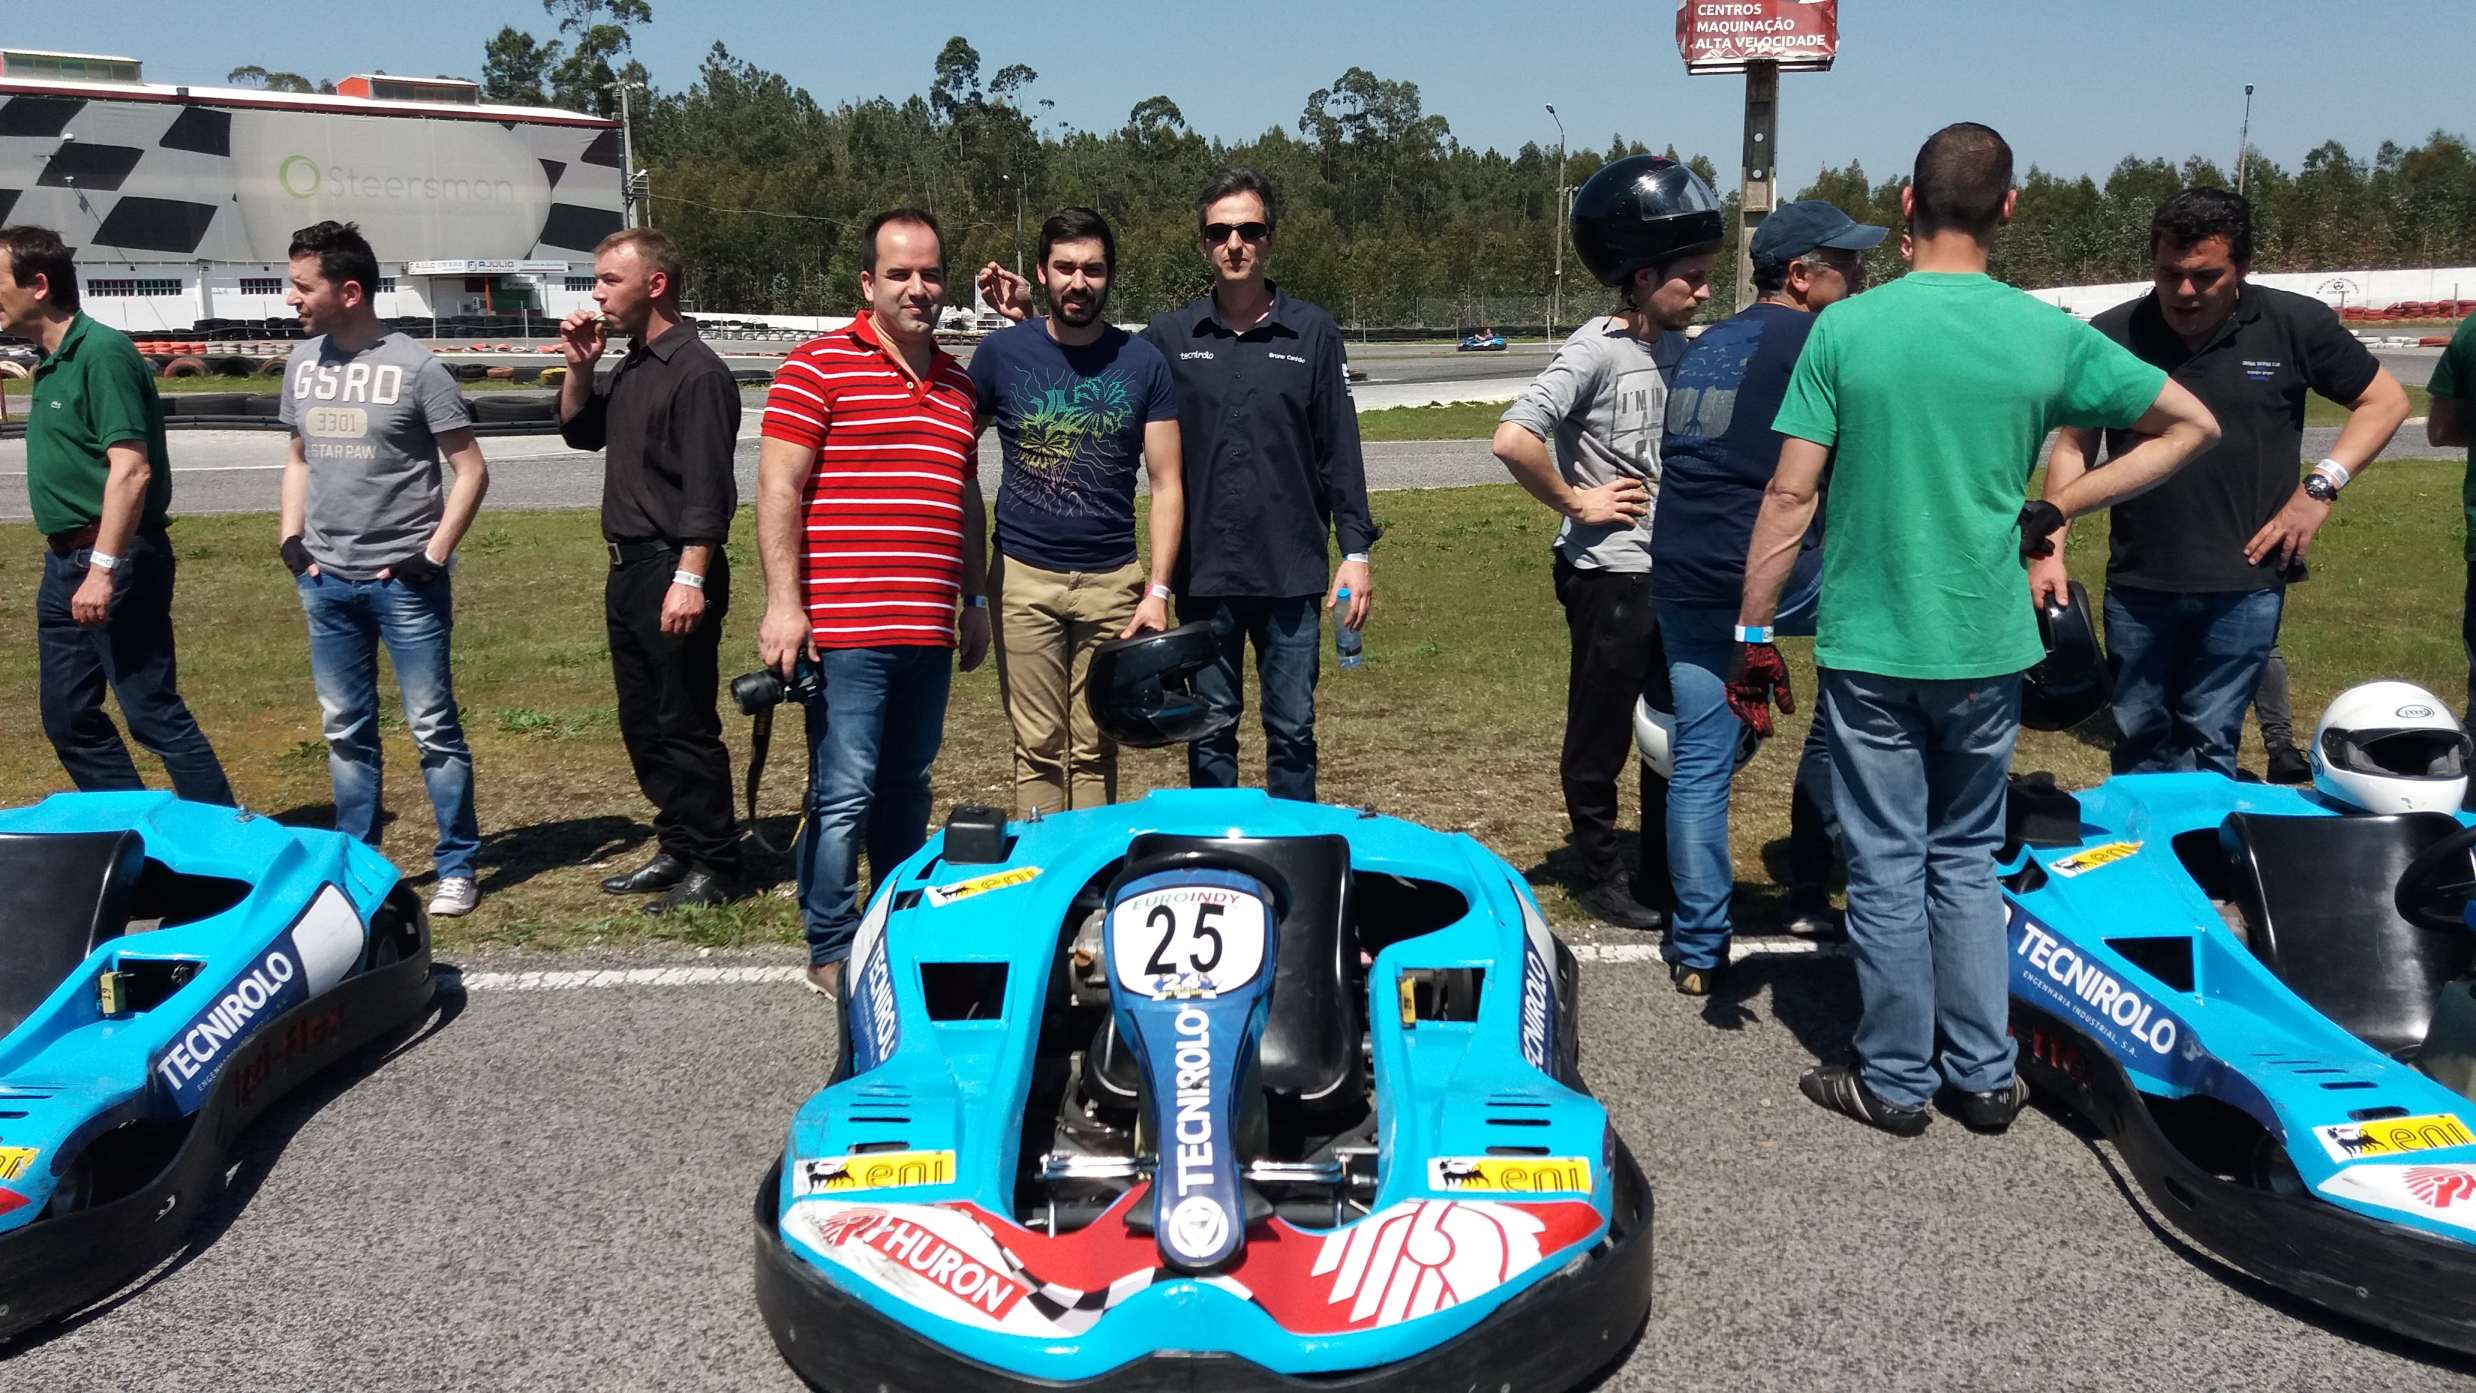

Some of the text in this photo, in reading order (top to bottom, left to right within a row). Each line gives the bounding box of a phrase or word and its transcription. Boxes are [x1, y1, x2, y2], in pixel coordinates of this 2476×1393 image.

[1696, 17, 1795, 34] MAQUINAÇÃO
[1698, 3, 1762, 16] CENTROS
[1696, 35, 1826, 49] ALTA VELOCIDADE
[328, 166, 514, 200] Steersman
[294, 360, 402, 405] GSRD
[317, 413, 356, 433] 3301
[1133, 891, 1241, 911] EUROINDY
[1144, 902, 1225, 976] 25
[2017, 922, 2177, 1054] TECNIROLO
[157, 951, 294, 1090] TECNIROLO
[1524, 951, 1547, 1073] ECNIROLO
[1175, 1008, 1214, 1197] TECNIROLO
[2390, 1121, 2471, 1152] eni
[866, 1160, 944, 1188] eni
[1501, 1167, 1580, 1193] eni
[882, 1222, 1014, 1313] HURON
